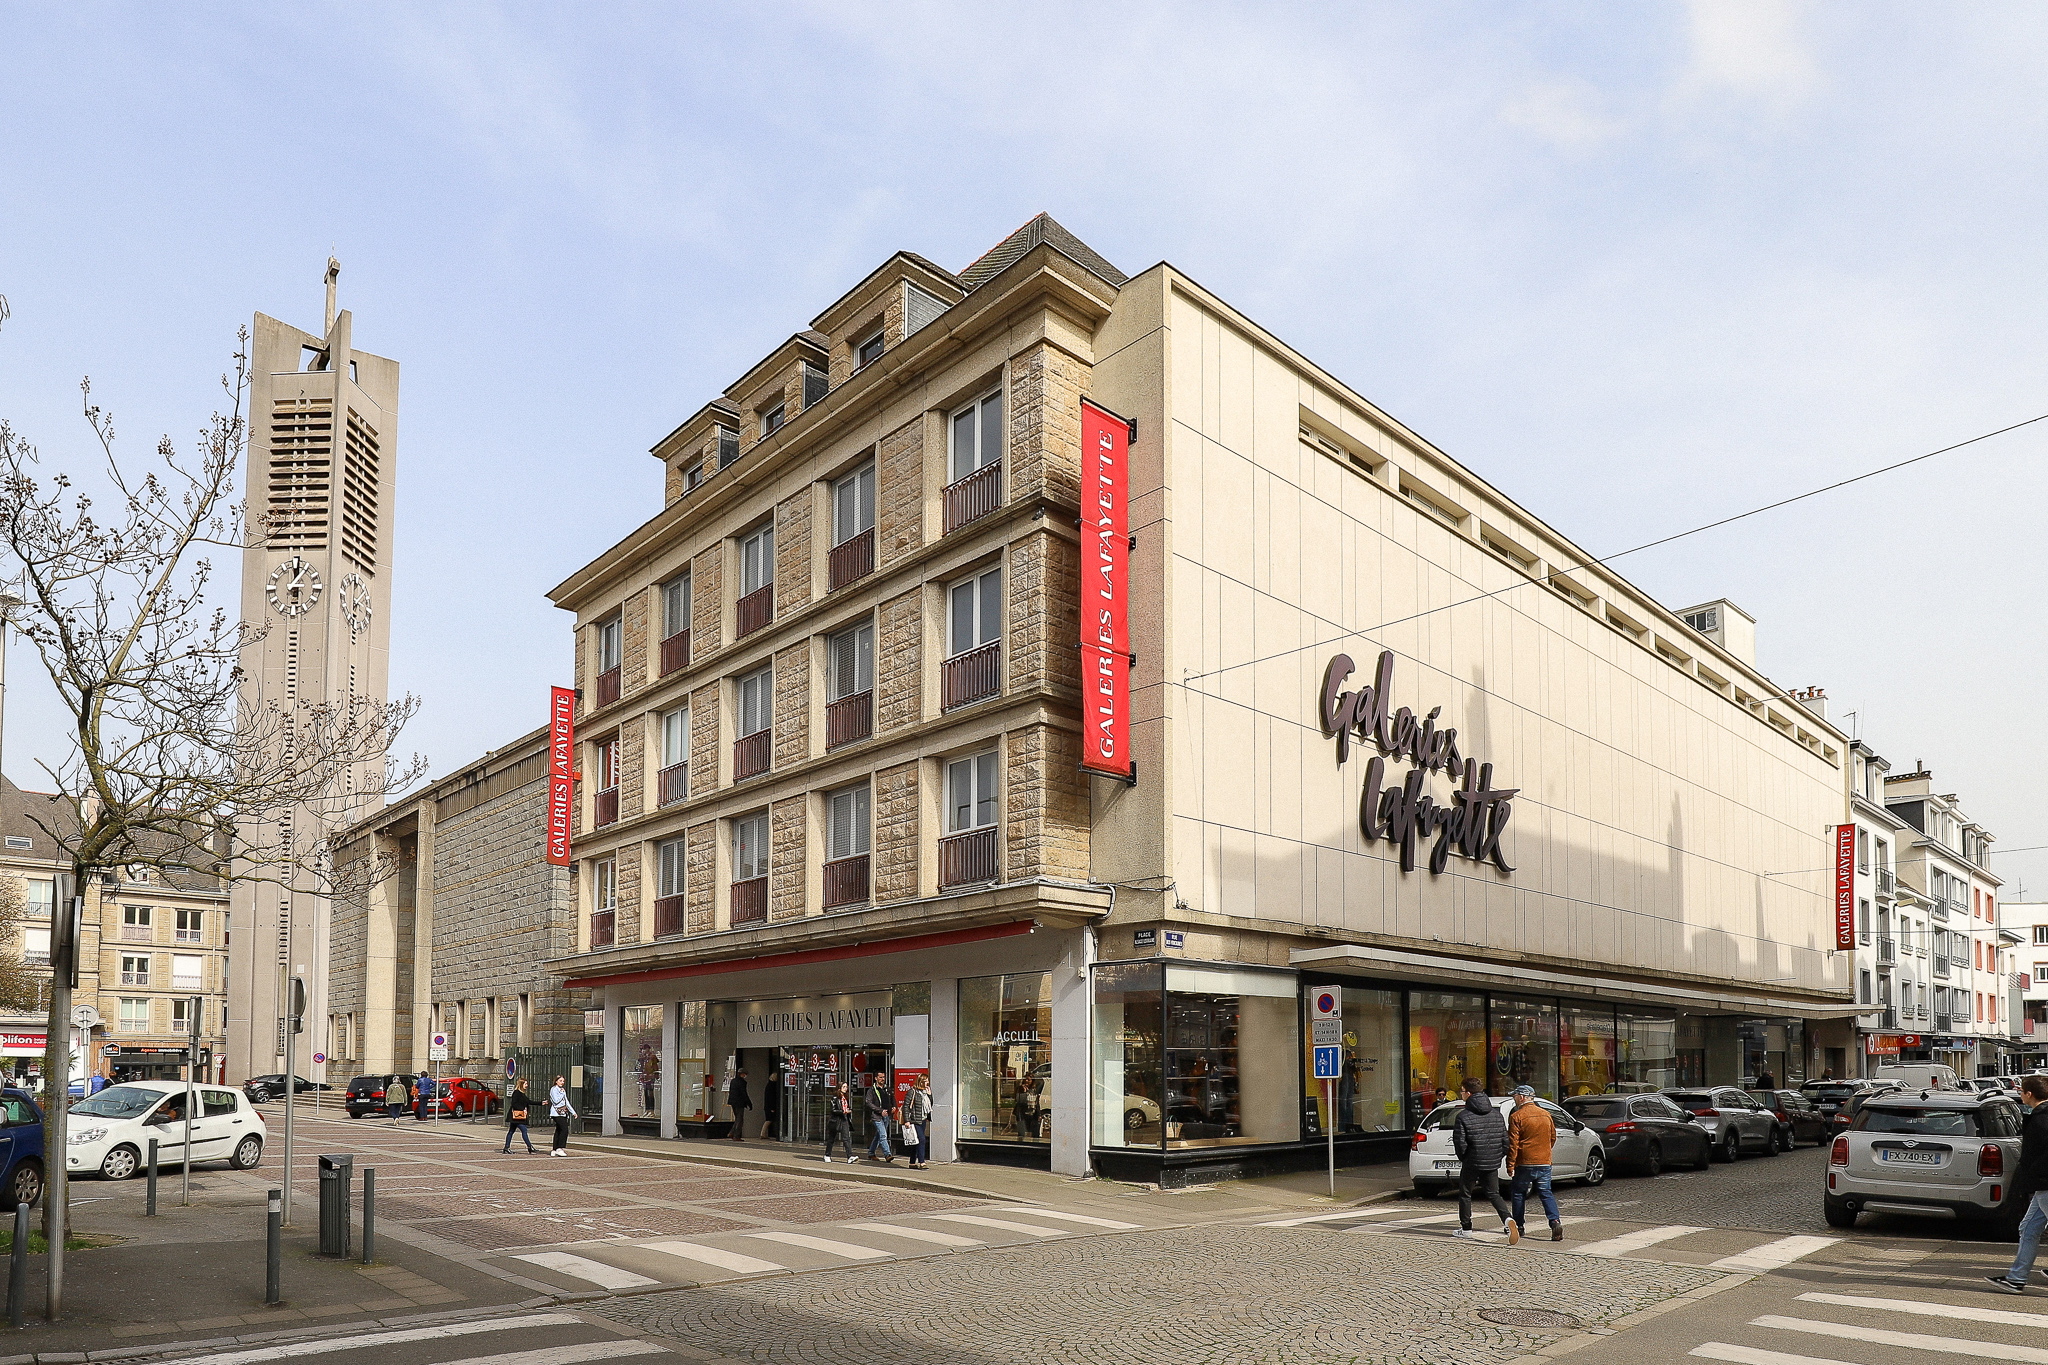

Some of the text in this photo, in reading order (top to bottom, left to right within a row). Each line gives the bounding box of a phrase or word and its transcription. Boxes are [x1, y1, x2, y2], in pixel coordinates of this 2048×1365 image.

[1098, 429, 1115, 759] GALERIES LAFAYETTE
[1319, 650, 1464, 776] Galeries
[552, 694, 570, 858] GALERIES LAFAYETTE
[1361, 755, 1521, 874] Lafayette
[1839, 829, 1852, 944] GALERIES LAFAYETTE
[747, 1006, 893, 1033] GALERIES LAFAYETT
[996, 1030, 1041, 1042] ACCUEIL
[1888, 1151, 1934, 1162] FX-740-EX
